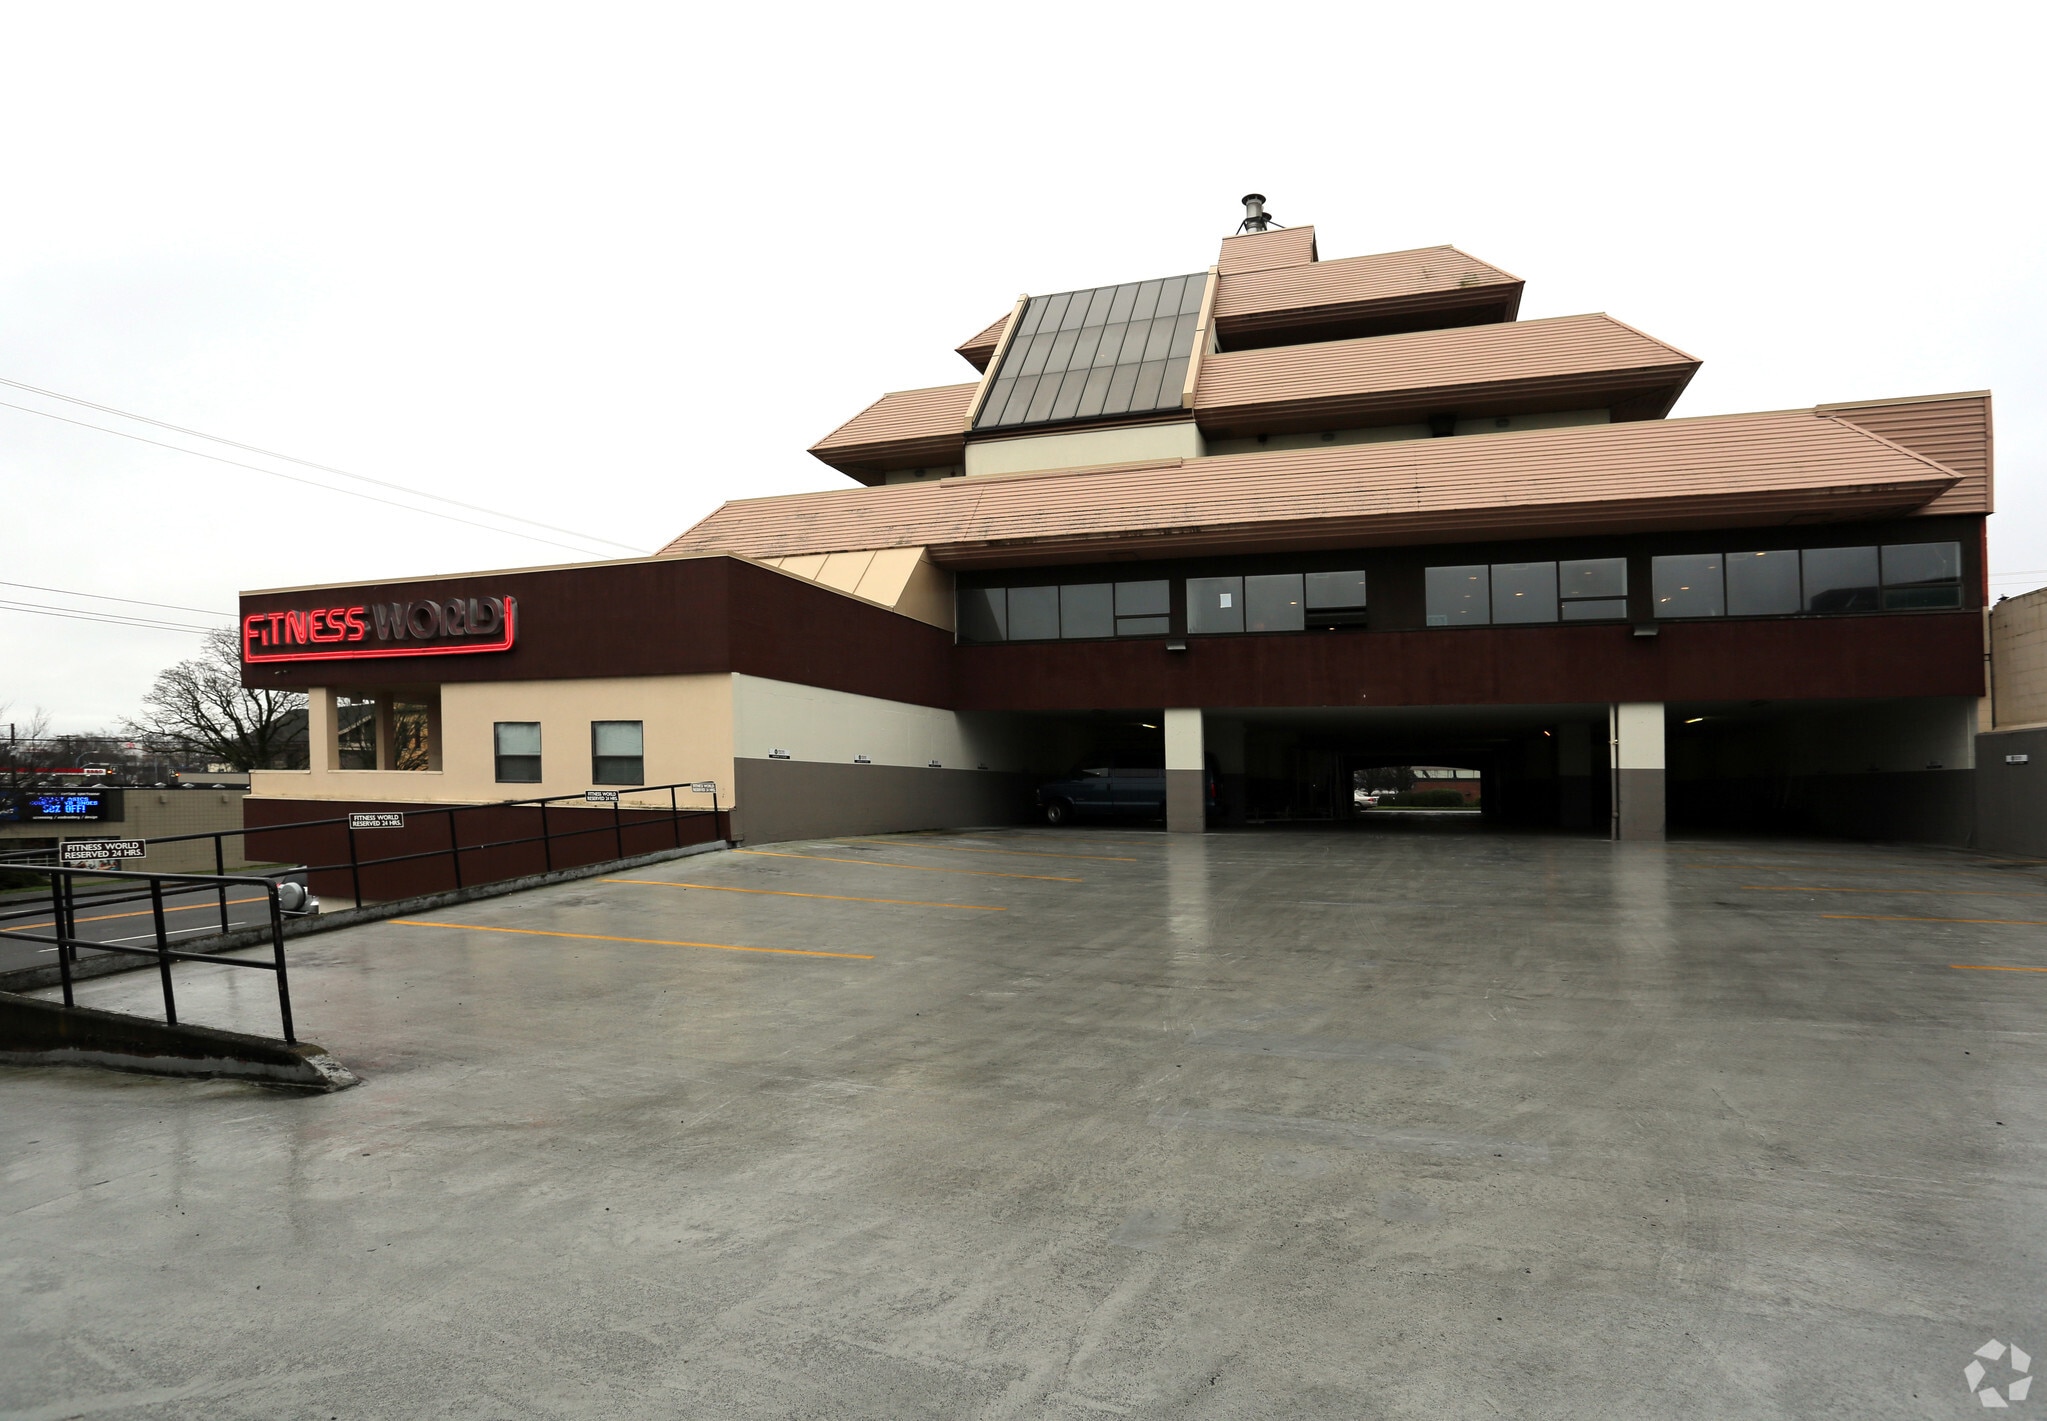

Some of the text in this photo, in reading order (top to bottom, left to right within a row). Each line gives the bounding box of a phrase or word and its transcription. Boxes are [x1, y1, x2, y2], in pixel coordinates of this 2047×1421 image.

[372, 597, 504, 641] WORLD
[65, 805, 86, 813] OFF!
[67, 842, 139, 851] FITNESS WORLD
[64, 850, 109, 859] RESERVED
